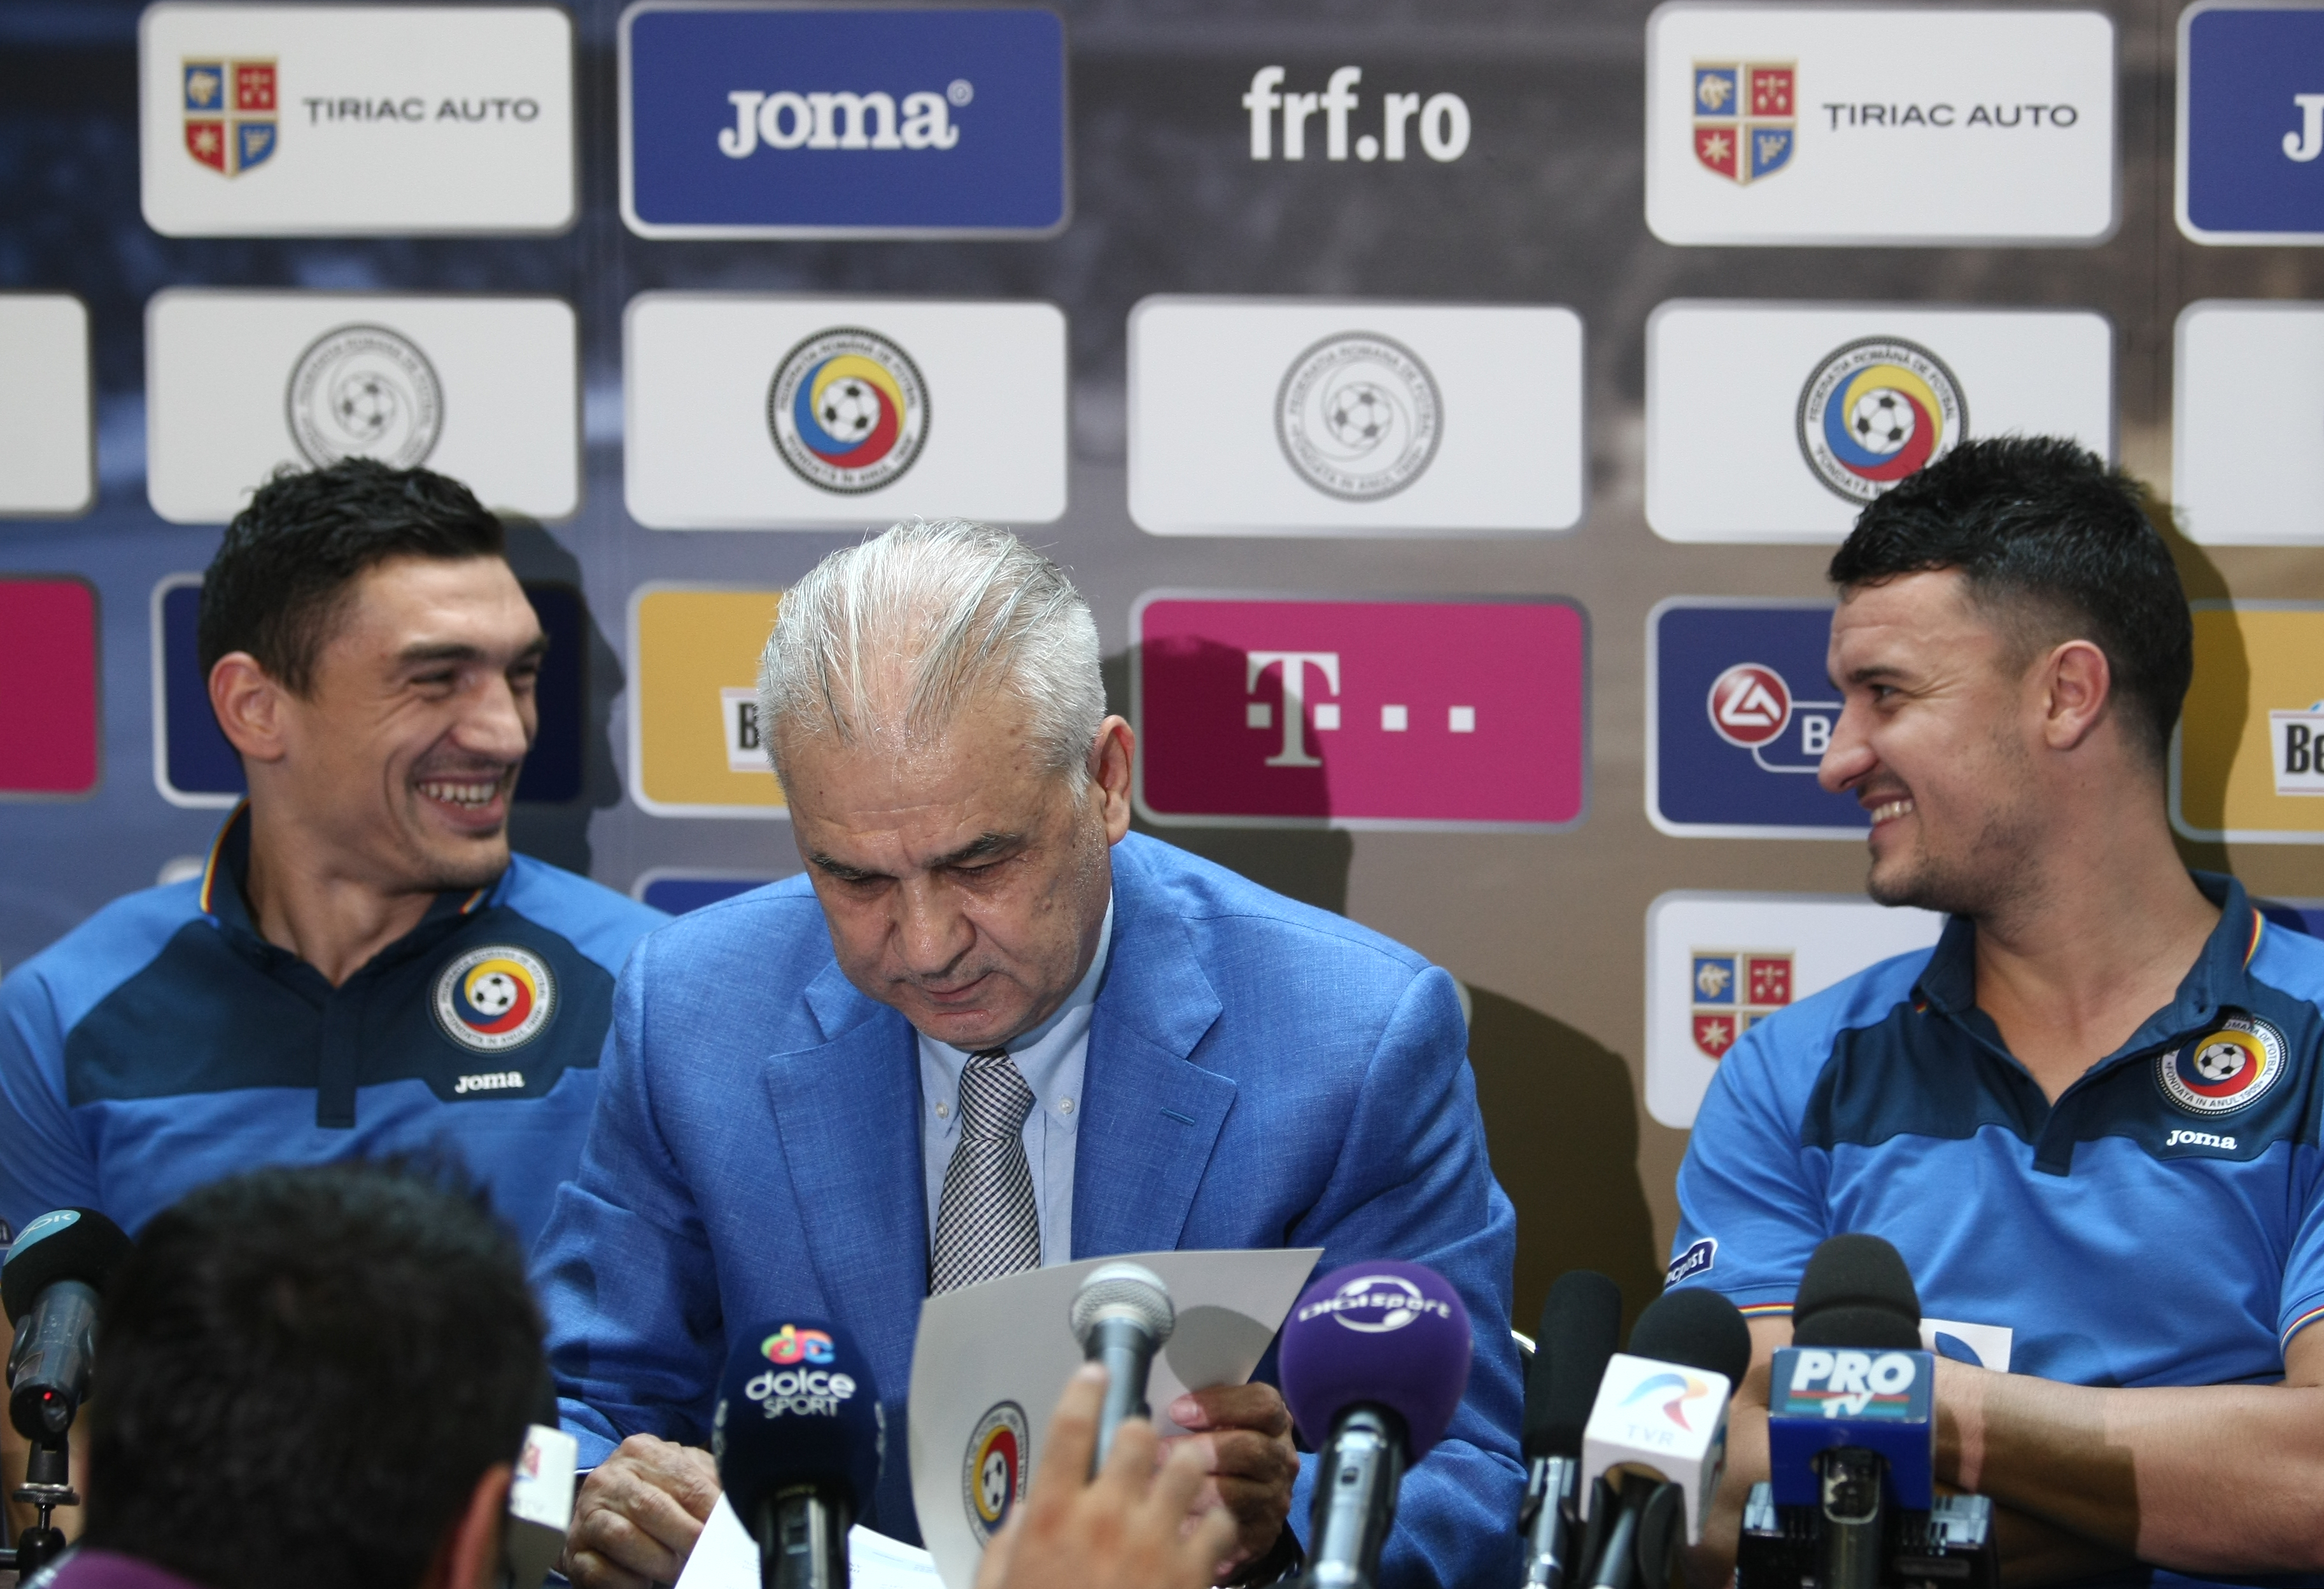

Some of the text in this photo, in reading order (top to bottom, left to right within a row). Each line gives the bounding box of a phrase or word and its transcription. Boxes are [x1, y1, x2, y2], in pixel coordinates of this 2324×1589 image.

[436, 97, 540, 122] AUTO
[1242, 66, 1472, 163] frf.ro
[1967, 103, 2079, 127] AUTO
[745, 1367, 857, 1400] dolce
[1791, 1350, 1916, 1395] PRO
[763, 1394, 840, 1419] SPORT
[1628, 1424, 1675, 1446] TVR
